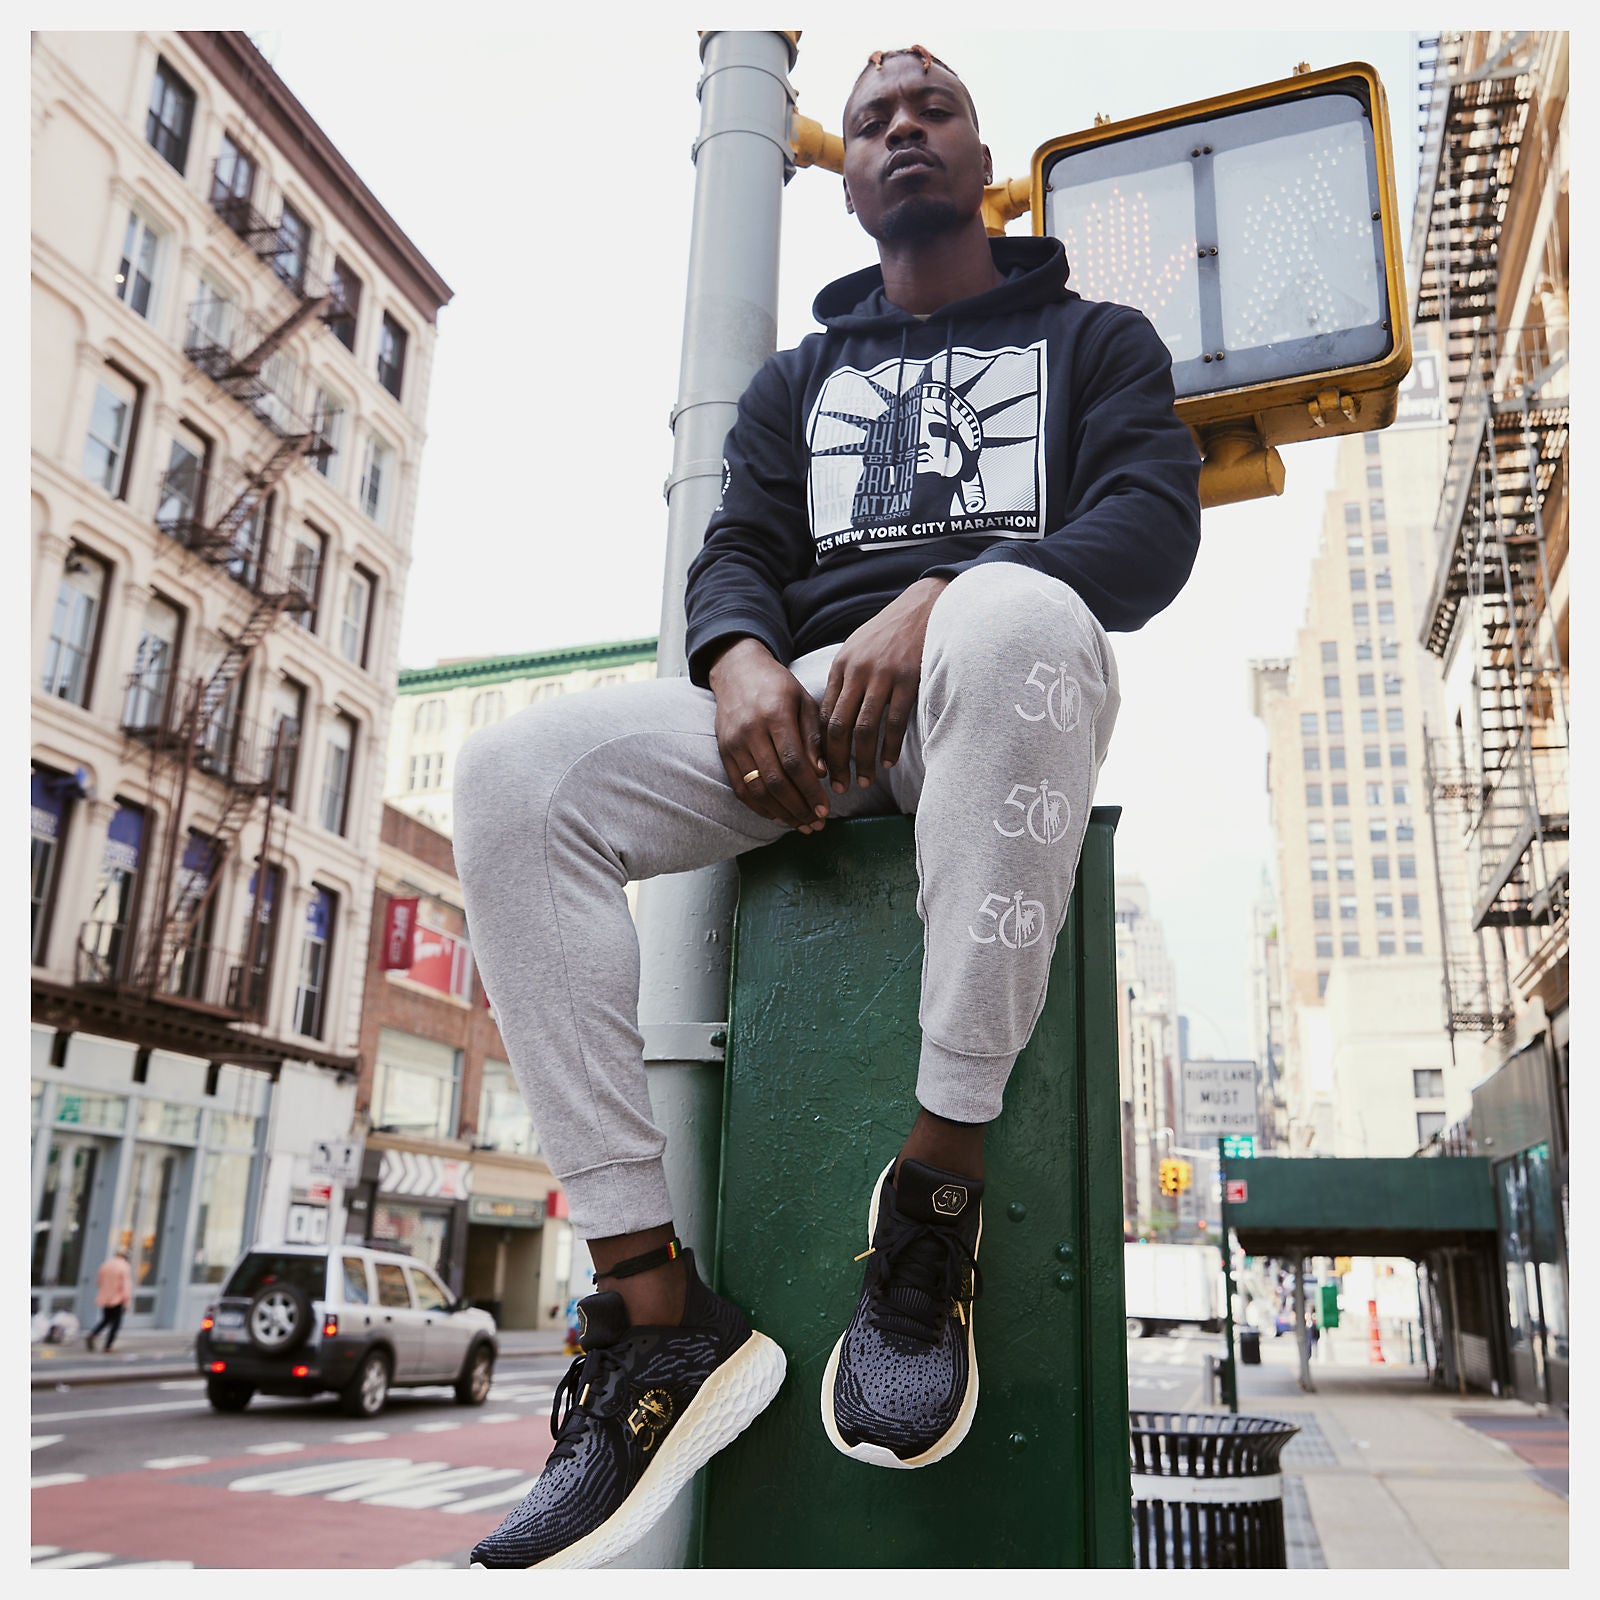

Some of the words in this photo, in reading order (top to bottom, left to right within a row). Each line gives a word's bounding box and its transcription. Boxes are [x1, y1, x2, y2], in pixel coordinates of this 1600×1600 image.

[816, 537, 833, 553] TCS
[834, 529, 865, 546] NEW
[867, 524, 908, 539] YORK
[911, 521, 946, 536] CITY
[950, 515, 1037, 531] MARATHON
